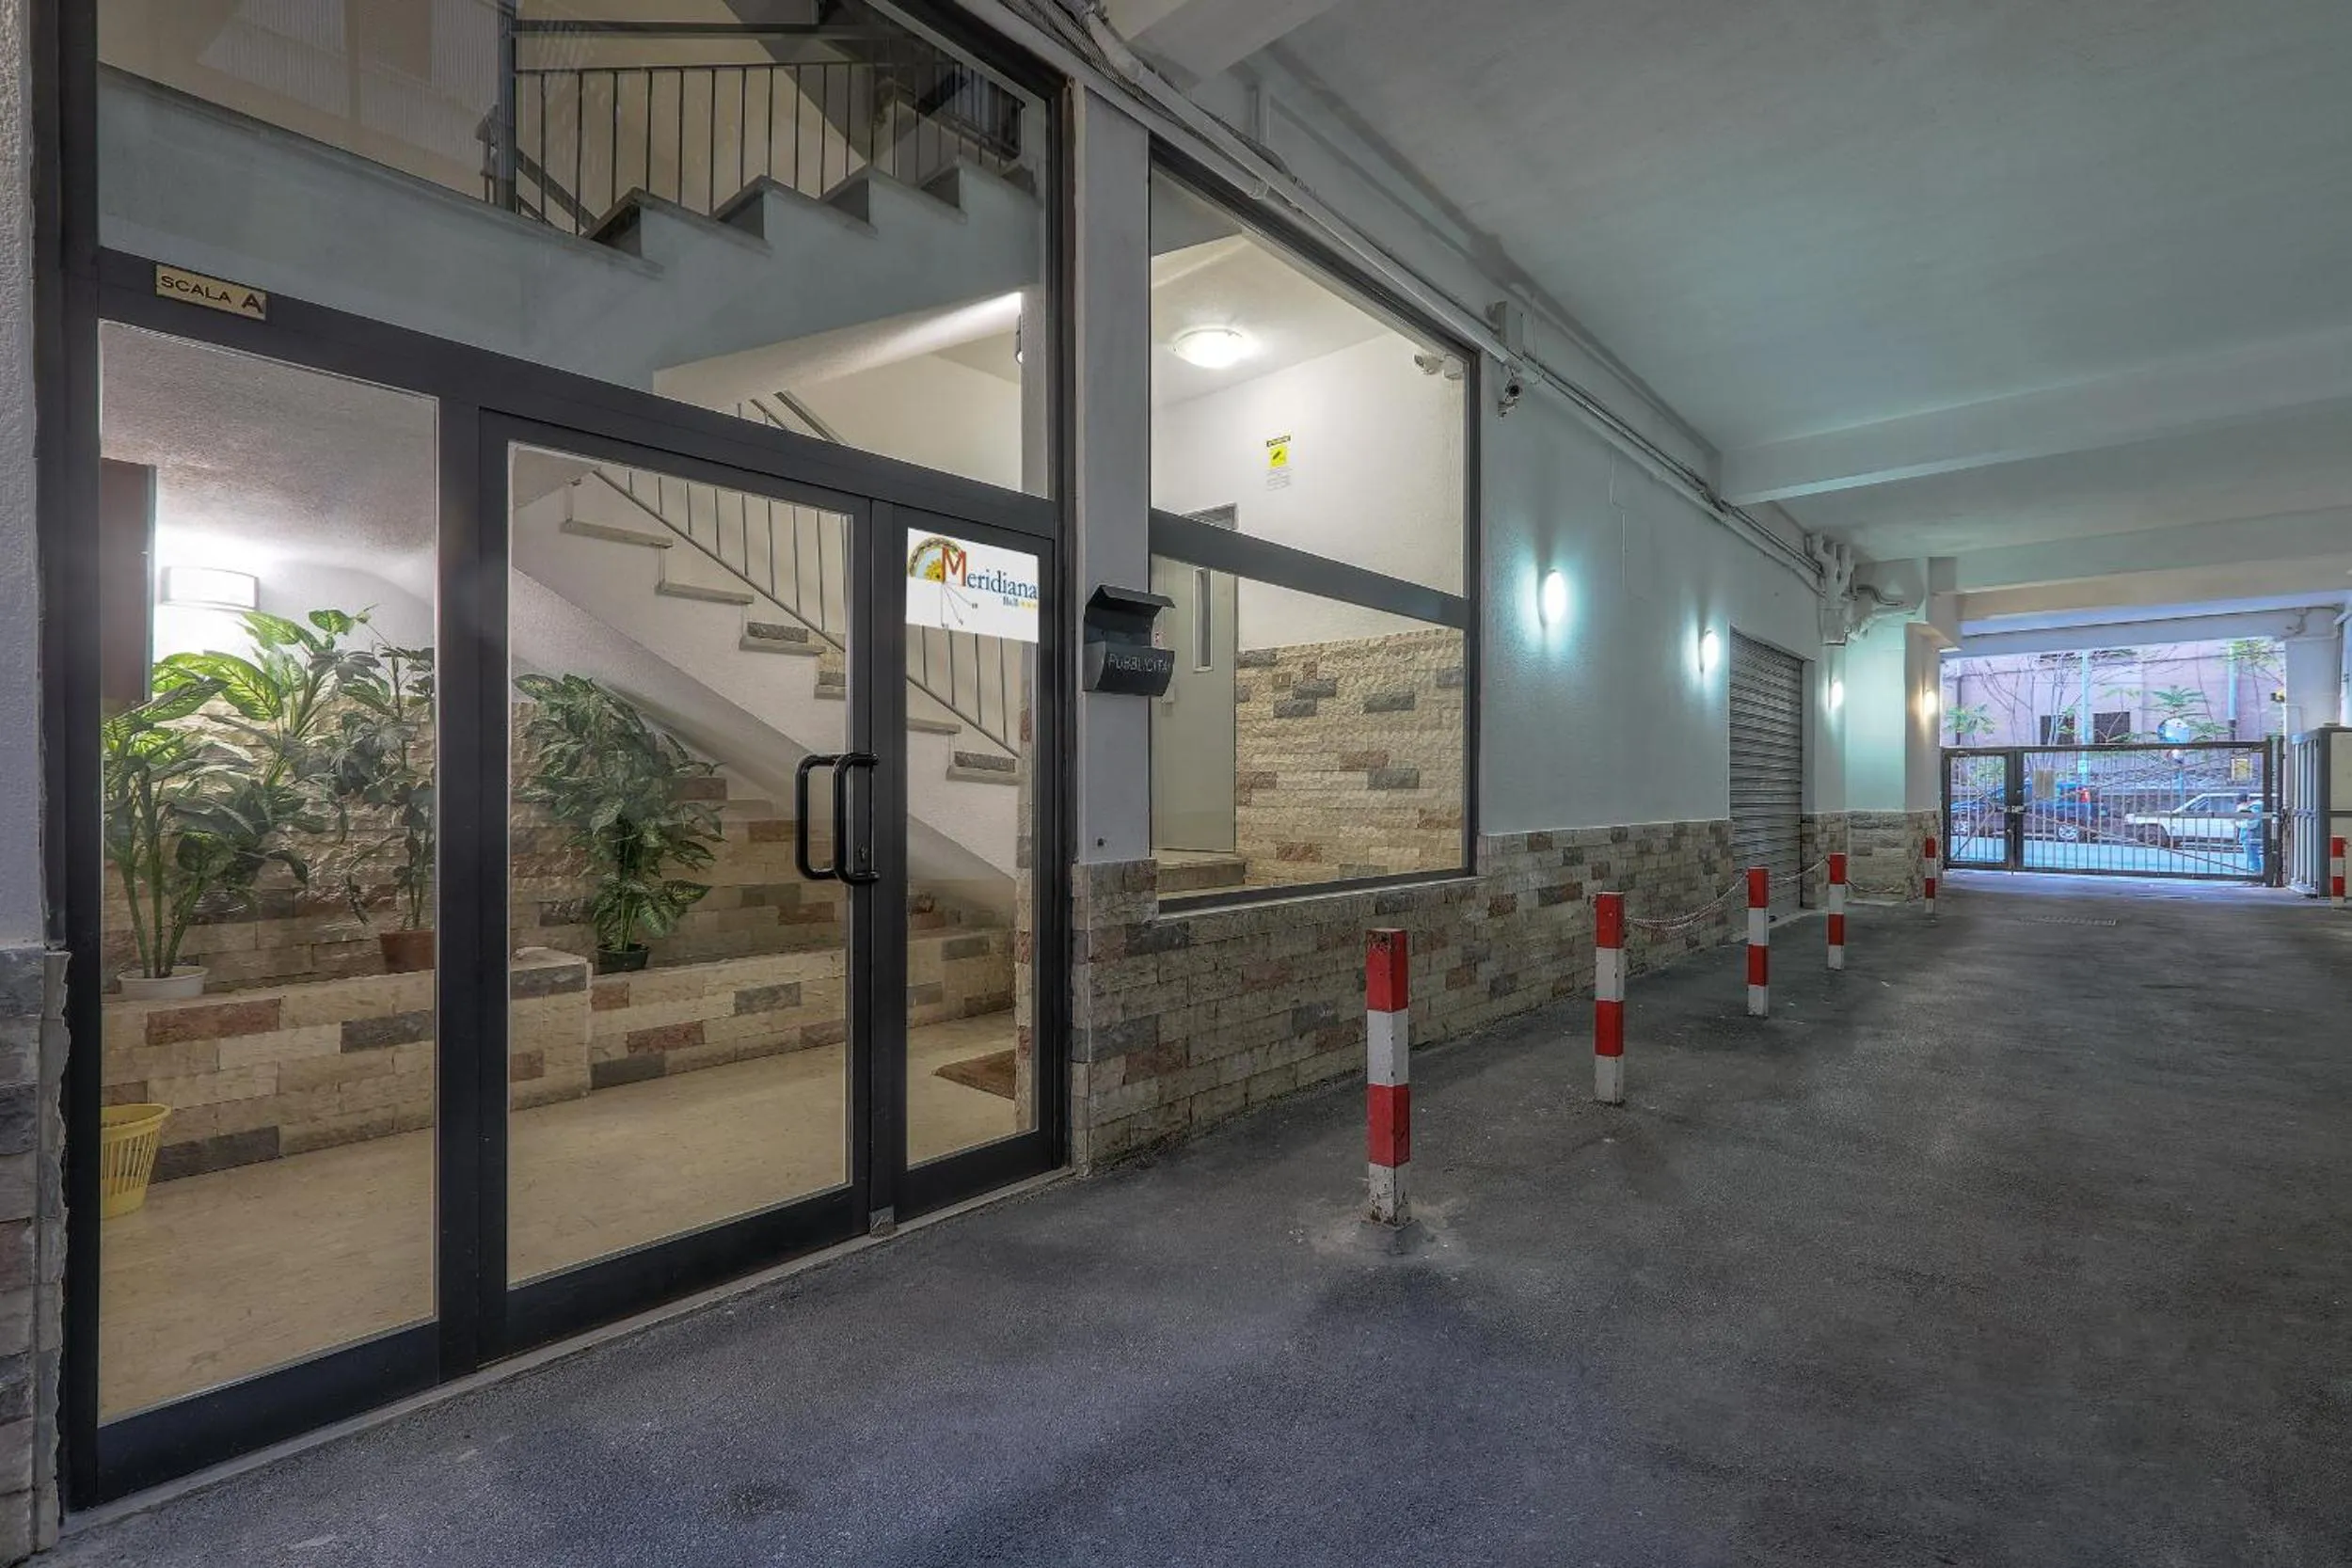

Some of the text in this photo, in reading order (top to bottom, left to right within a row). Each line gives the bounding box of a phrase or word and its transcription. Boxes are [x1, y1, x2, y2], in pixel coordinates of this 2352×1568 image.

[161, 275, 263, 313] SCALA A
[942, 545, 1038, 600] Meridiana
